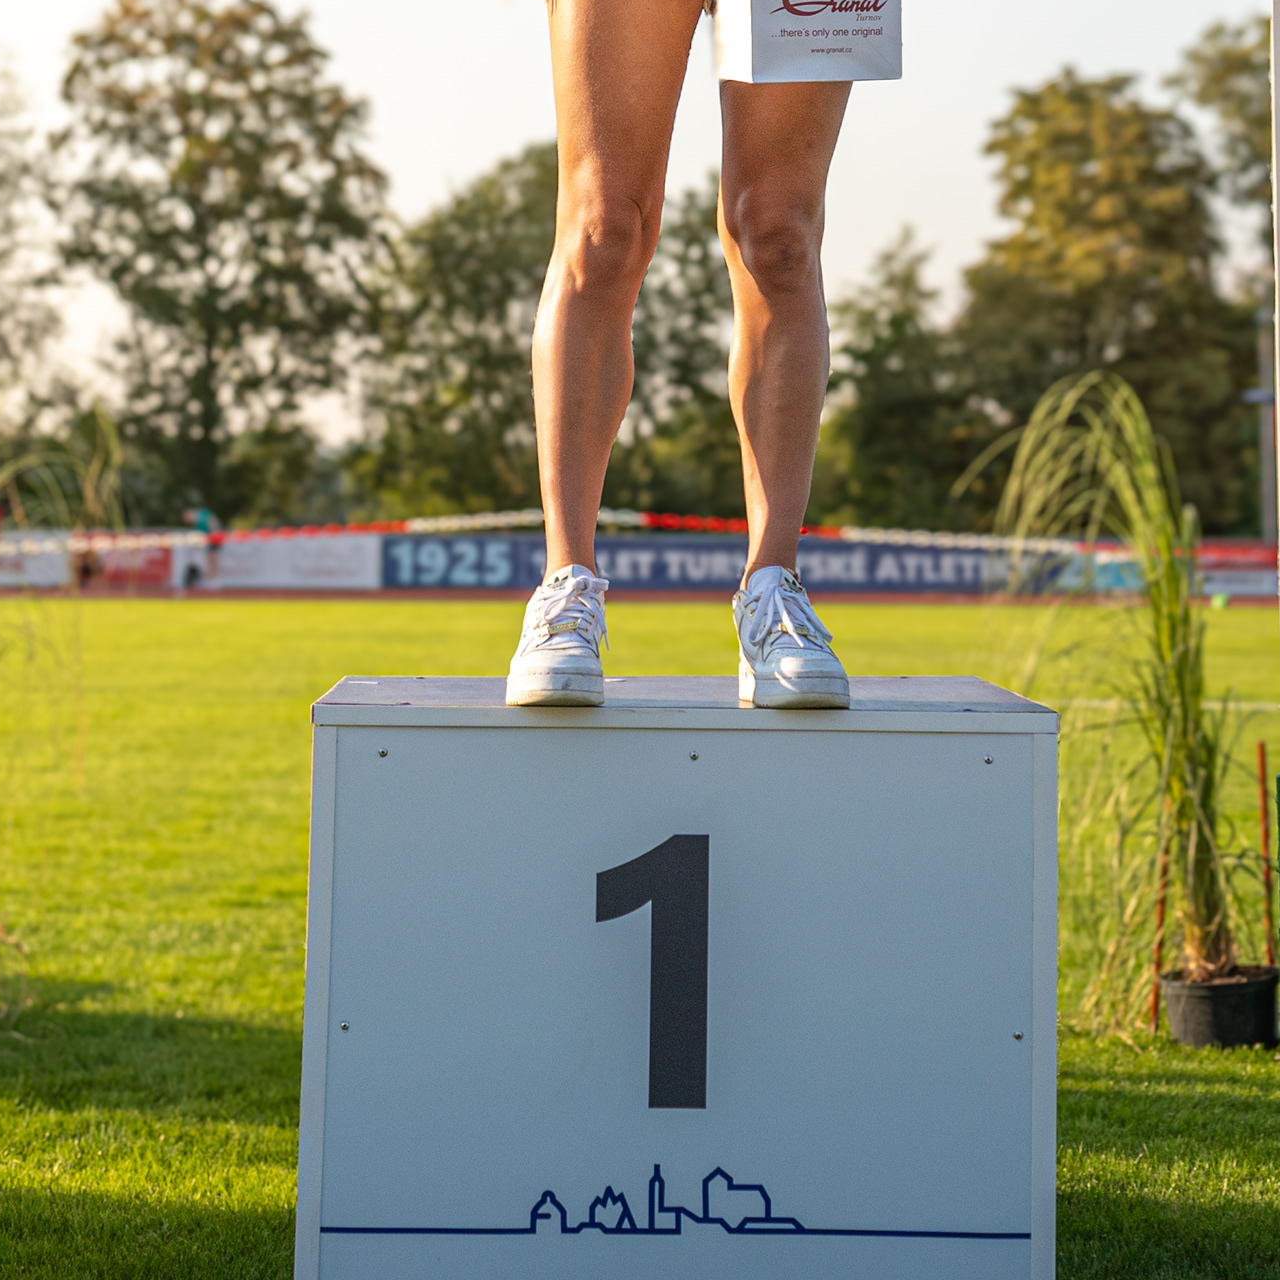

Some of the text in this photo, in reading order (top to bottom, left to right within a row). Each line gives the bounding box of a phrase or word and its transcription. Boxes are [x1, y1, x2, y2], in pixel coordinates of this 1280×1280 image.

[856, 14, 883, 22] Turnov
[812, 28, 830, 39] only
[851, 27, 883, 37] original
[390, 542, 513, 585] 1925
[663, 549, 867, 582] TURSKÉ
[595, 834, 710, 1109] 1
